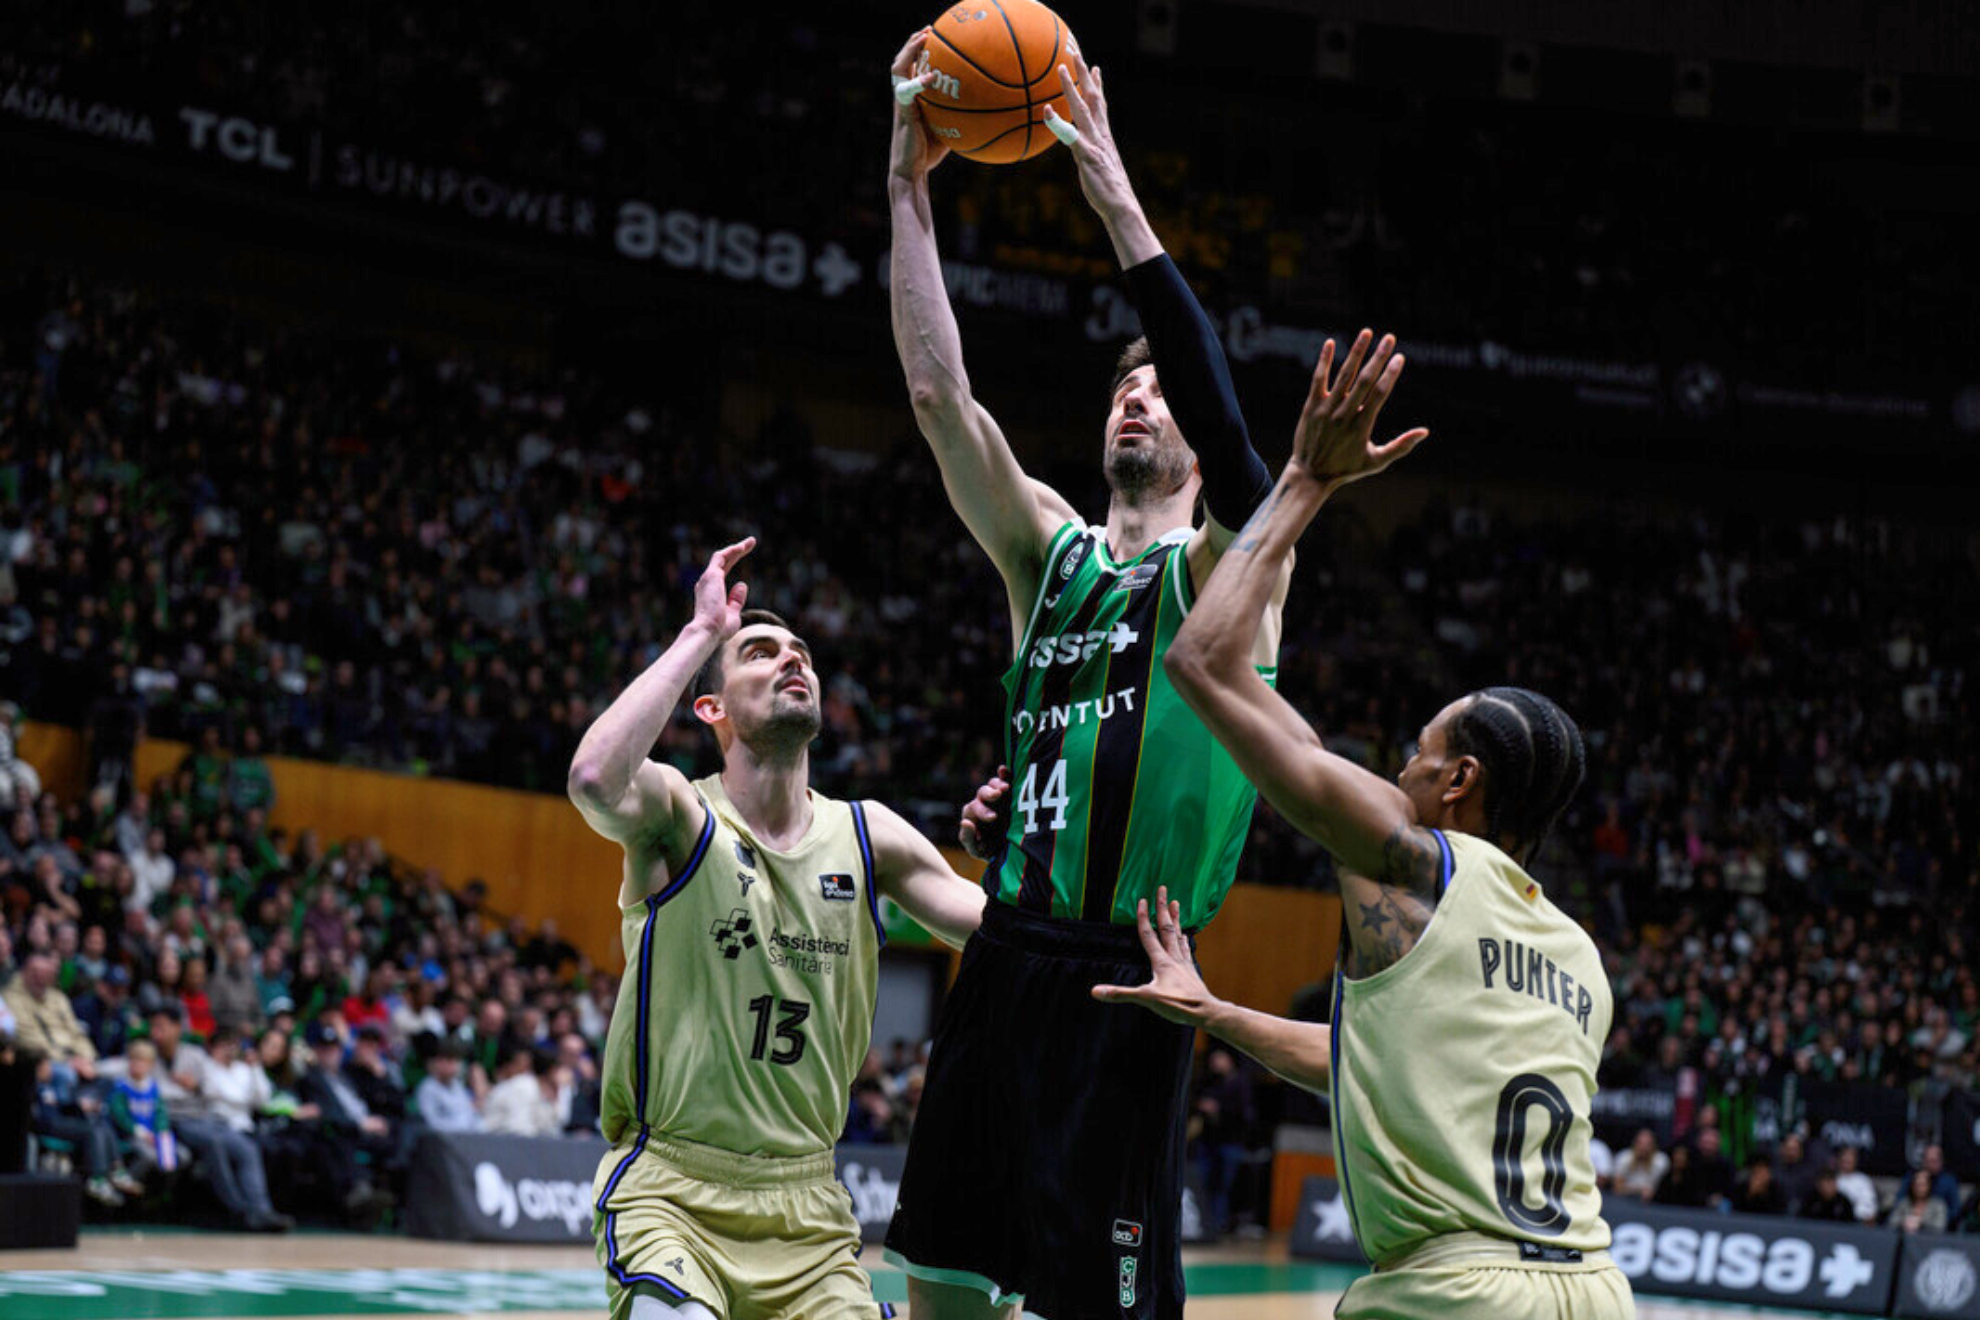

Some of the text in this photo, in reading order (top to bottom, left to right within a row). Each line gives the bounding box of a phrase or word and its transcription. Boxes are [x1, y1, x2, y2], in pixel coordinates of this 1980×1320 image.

[0, 80, 155, 145] ADALONA
[179, 105, 596, 236] TCL SUNPOWER
[614, 199, 807, 291] asisa
[1017, 759, 1070, 834] 44
[769, 927, 850, 957] Assistènci
[1478, 938, 1592, 1036] PUNTER
[750, 995, 810, 1065] 13
[1493, 1074, 1573, 1238] 0
[1610, 1222, 1815, 1294] asisa
